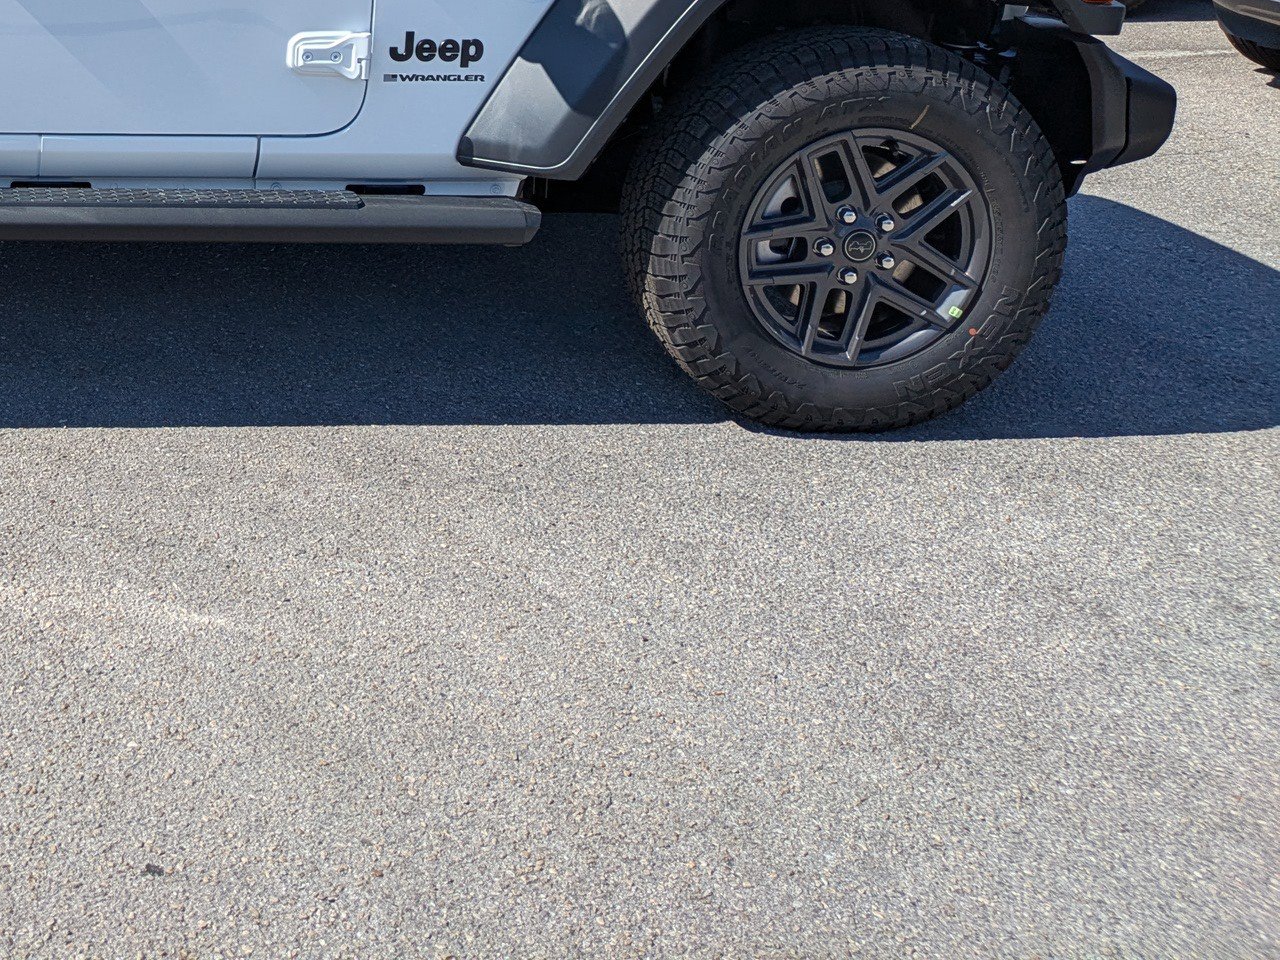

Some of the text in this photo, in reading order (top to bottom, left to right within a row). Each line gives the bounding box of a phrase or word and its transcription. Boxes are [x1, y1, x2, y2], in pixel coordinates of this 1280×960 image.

[389, 30, 484, 68] Jeep
[398, 74, 485, 82] WRANGLER
[892, 285, 1020, 402] NEXEN
